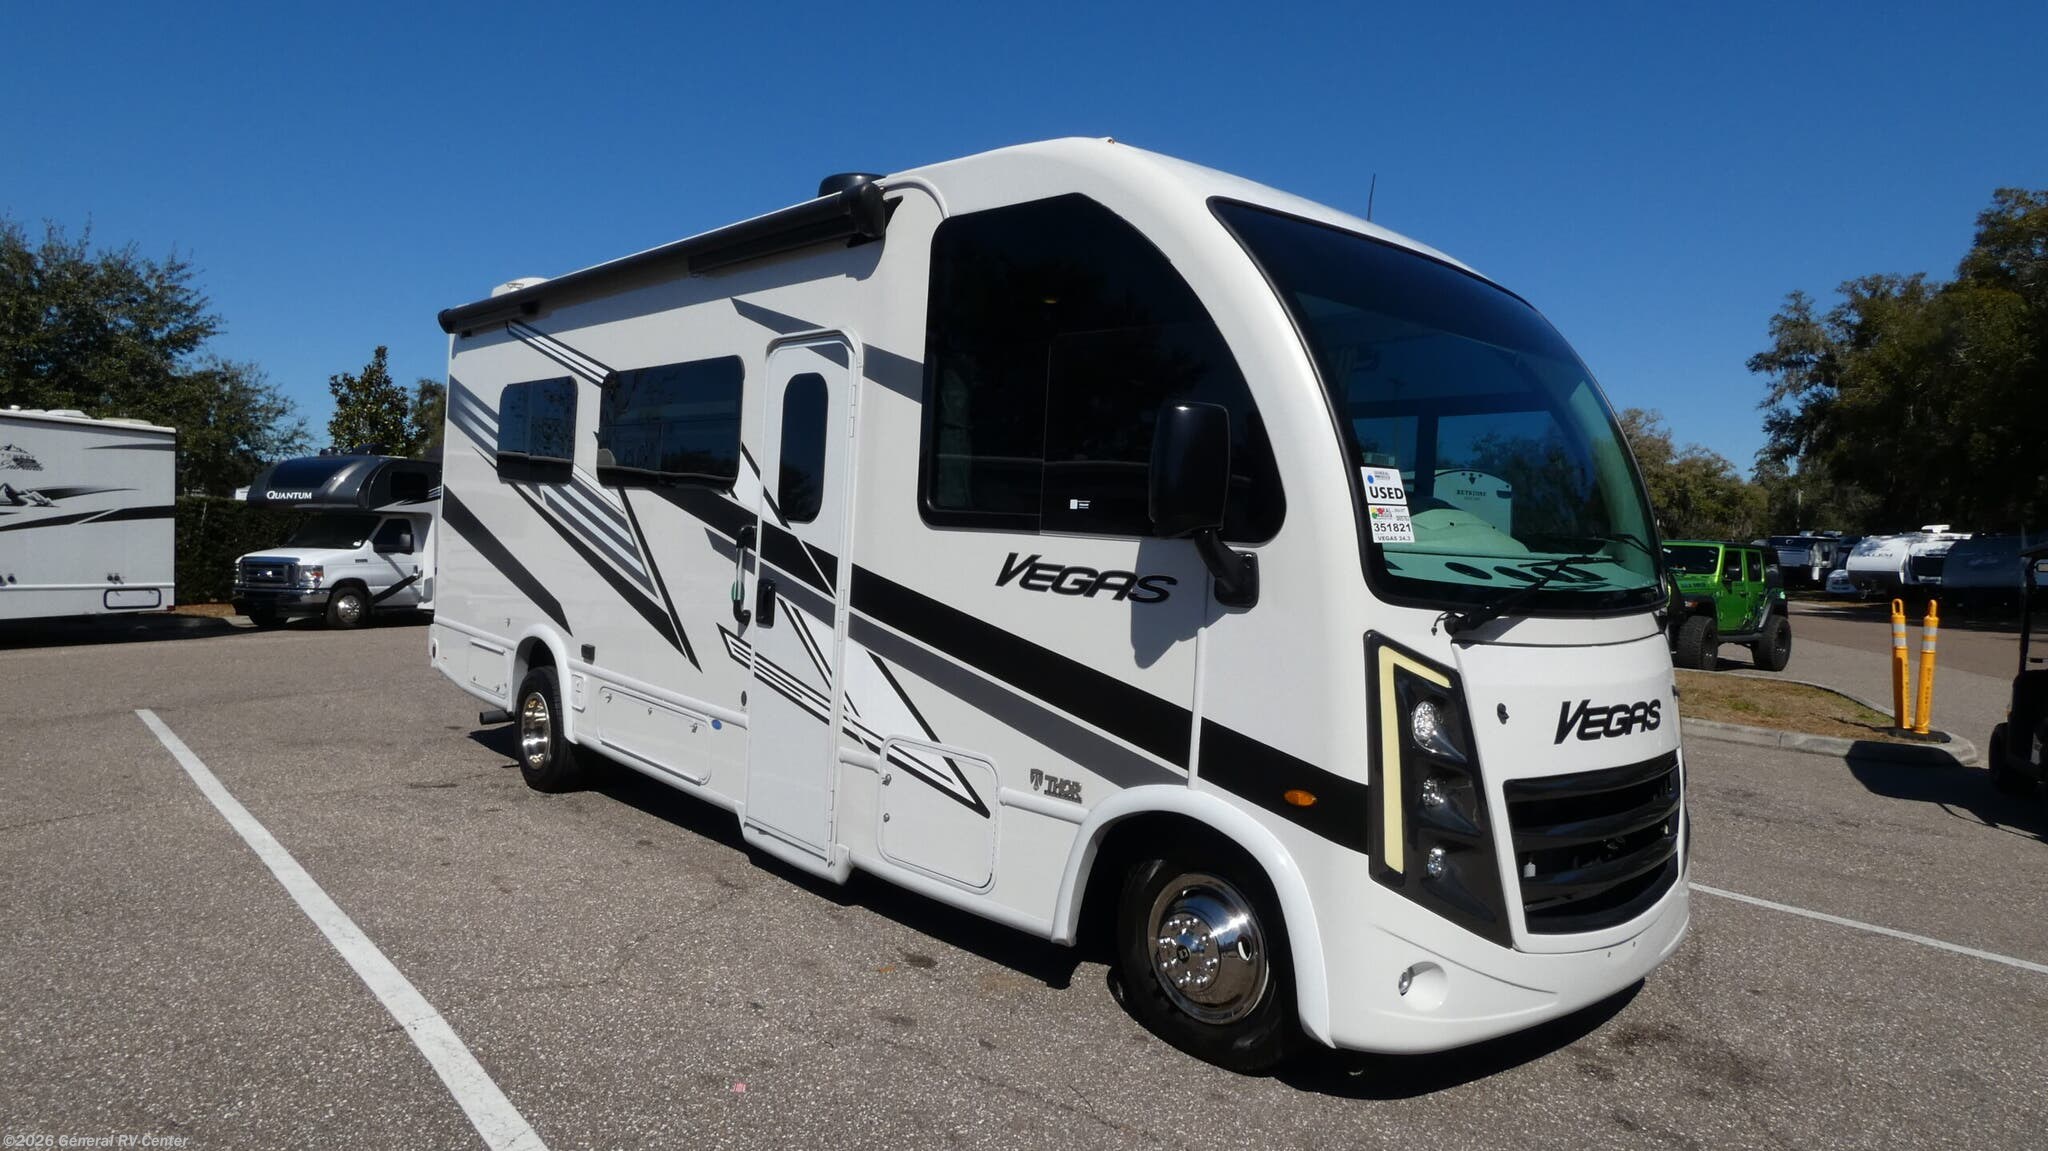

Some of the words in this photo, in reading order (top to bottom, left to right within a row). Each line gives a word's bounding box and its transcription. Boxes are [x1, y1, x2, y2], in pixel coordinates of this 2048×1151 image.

[266, 490, 312, 500] QUANTUM
[1369, 486, 1404, 499] USED
[1374, 523, 1411, 532] 351821
[995, 552, 1177, 603] VEGAS
[1554, 698, 1661, 744] VEGAS
[1044, 774, 1082, 801] THOR
